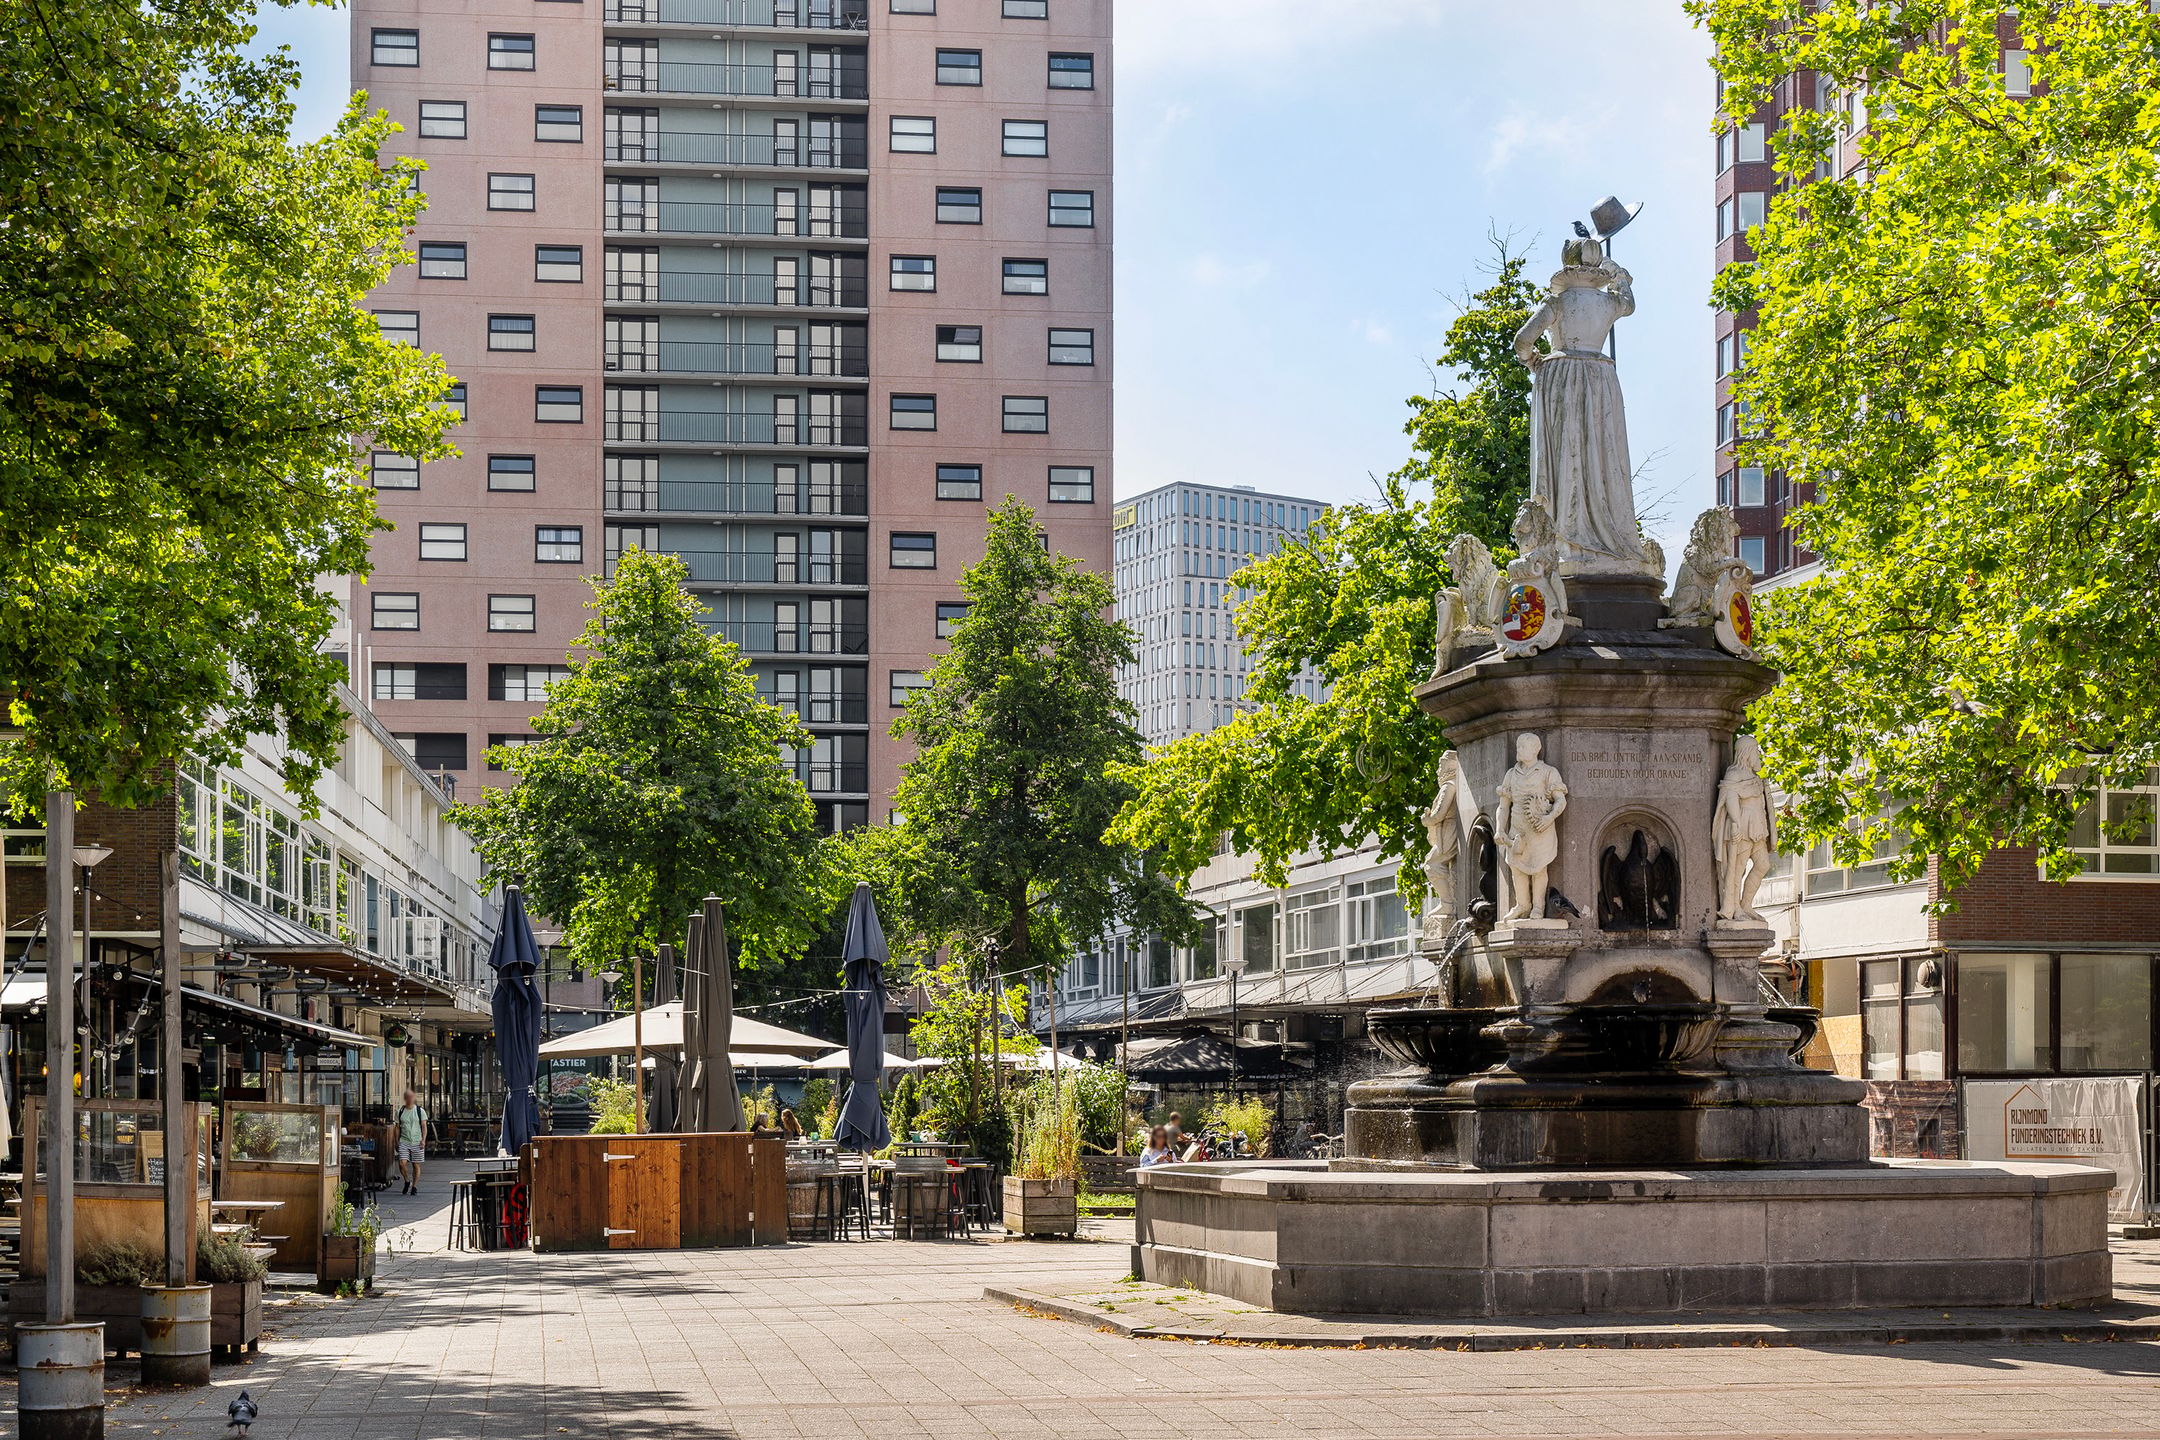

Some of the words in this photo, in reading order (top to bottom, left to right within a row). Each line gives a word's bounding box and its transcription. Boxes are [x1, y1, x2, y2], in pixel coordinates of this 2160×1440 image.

[1571, 752, 1587, 762] DEN
[1653, 752, 1670, 762] AAN
[1587, 768, 1631, 779] BEHOUDEN
[1632, 768, 1655, 779] DOOR
[1657, 769, 1687, 779] ORANJE
[2010, 1109, 2048, 1125] RIJNMOND
[2011, 1128, 2087, 1144] FUNDERINGSTECHNIEK
[2089, 1128, 2104, 1144] B.V.
